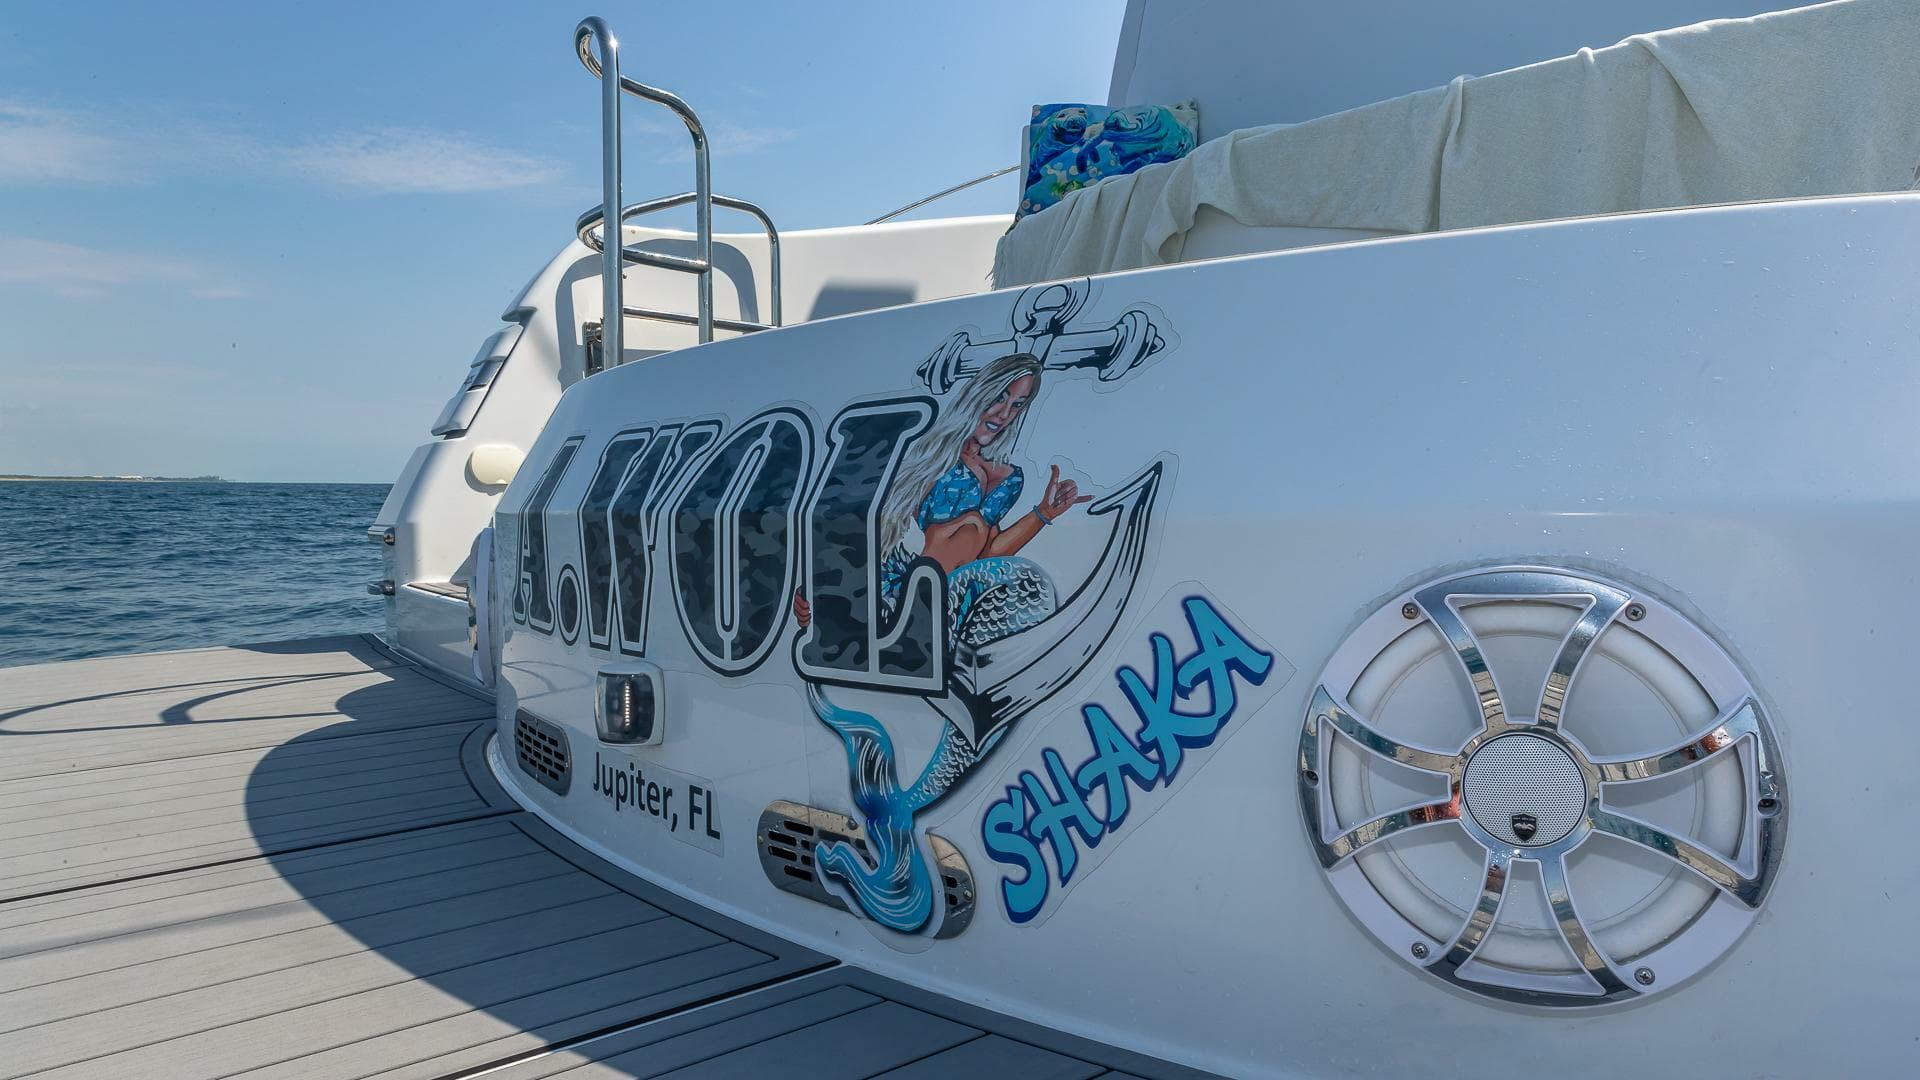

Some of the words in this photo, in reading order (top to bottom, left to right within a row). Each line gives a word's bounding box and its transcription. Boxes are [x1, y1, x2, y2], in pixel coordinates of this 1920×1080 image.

[593, 752, 677, 832] Jupiter,
[689, 785, 721, 840] FL
[982, 595, 1274, 923] SHAKA
